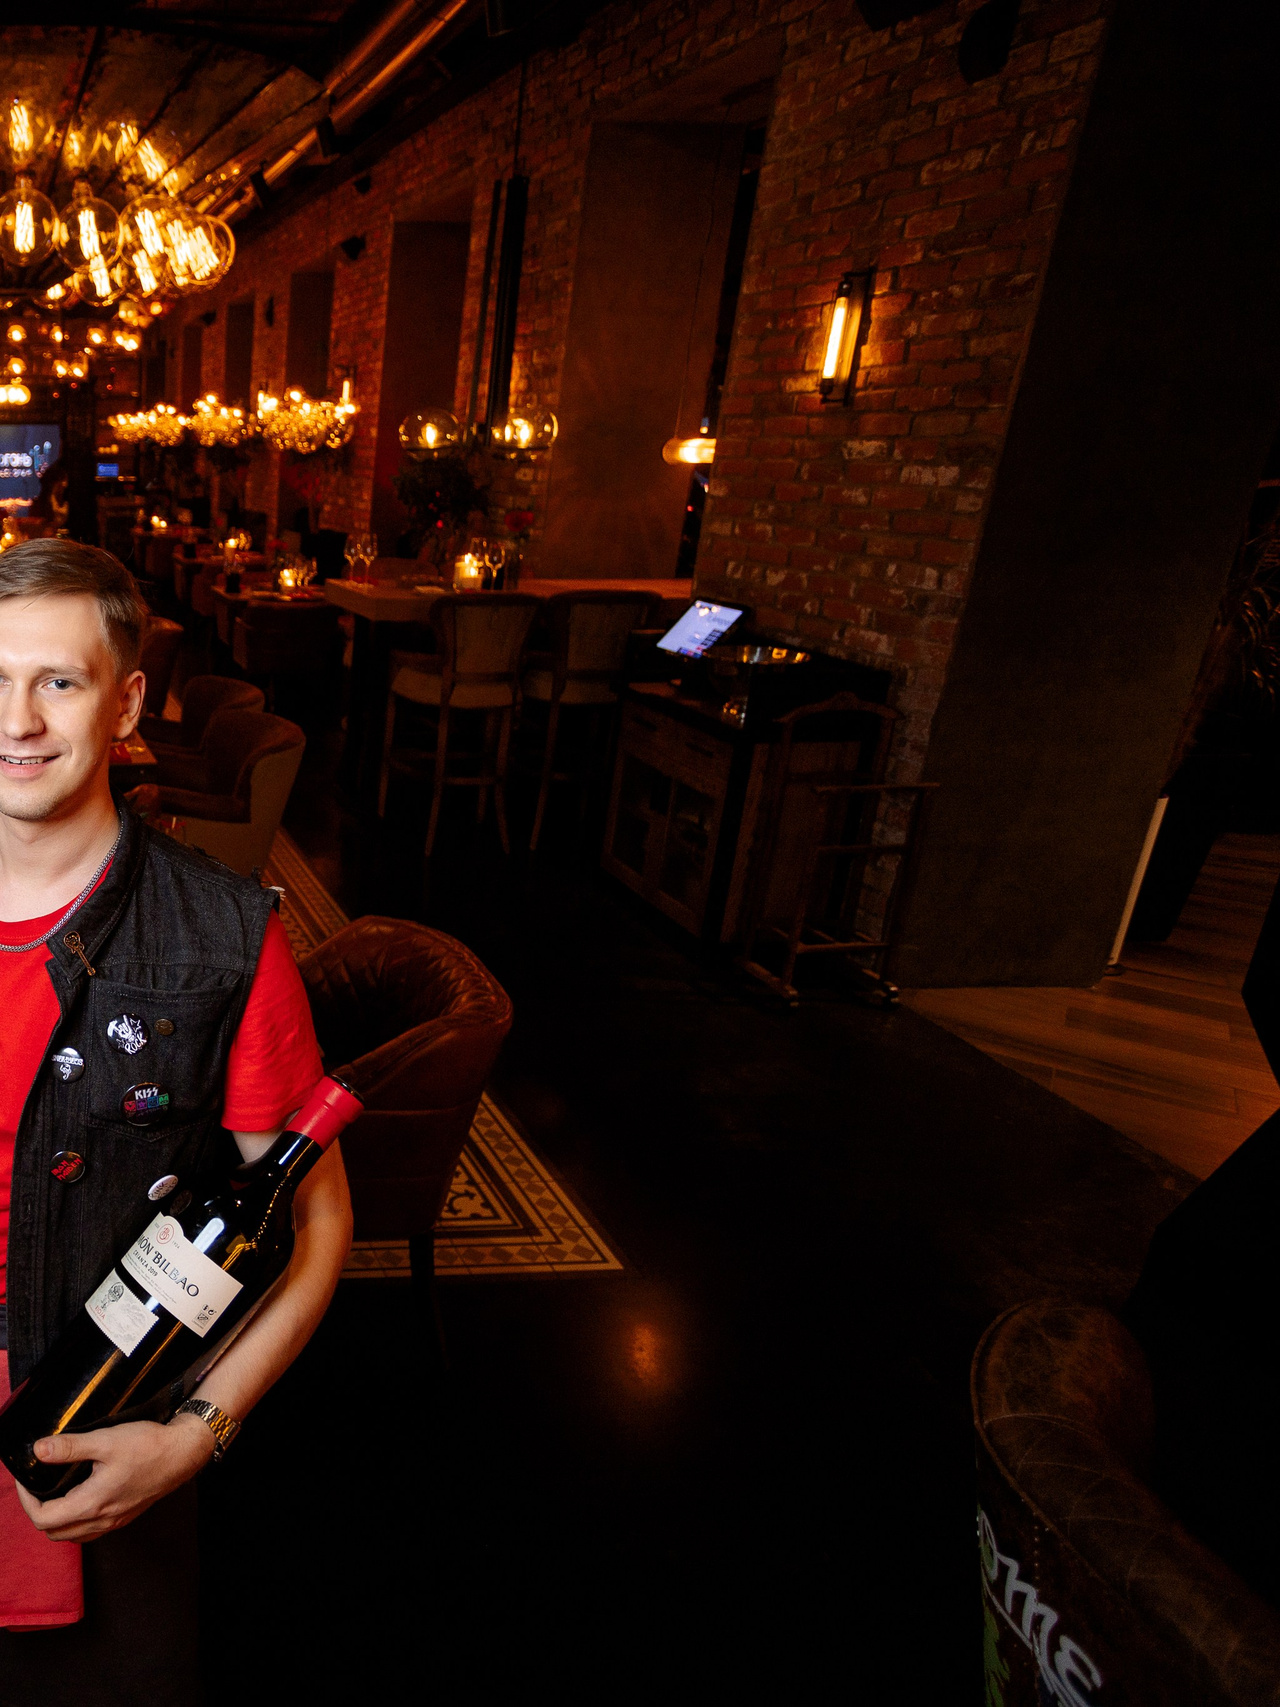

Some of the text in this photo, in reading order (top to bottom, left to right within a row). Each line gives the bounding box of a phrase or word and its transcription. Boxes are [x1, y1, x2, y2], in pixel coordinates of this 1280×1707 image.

[125, 1032, 147, 1054] ROCK
[134, 1087, 159, 1100] KISS
[51, 1160, 70, 1176] IRON
[56, 1158, 83, 1180] MAIDEN
[133, 1250, 158, 1277] CRIANZA 2019
[153, 1251, 199, 1297] BILBAO
